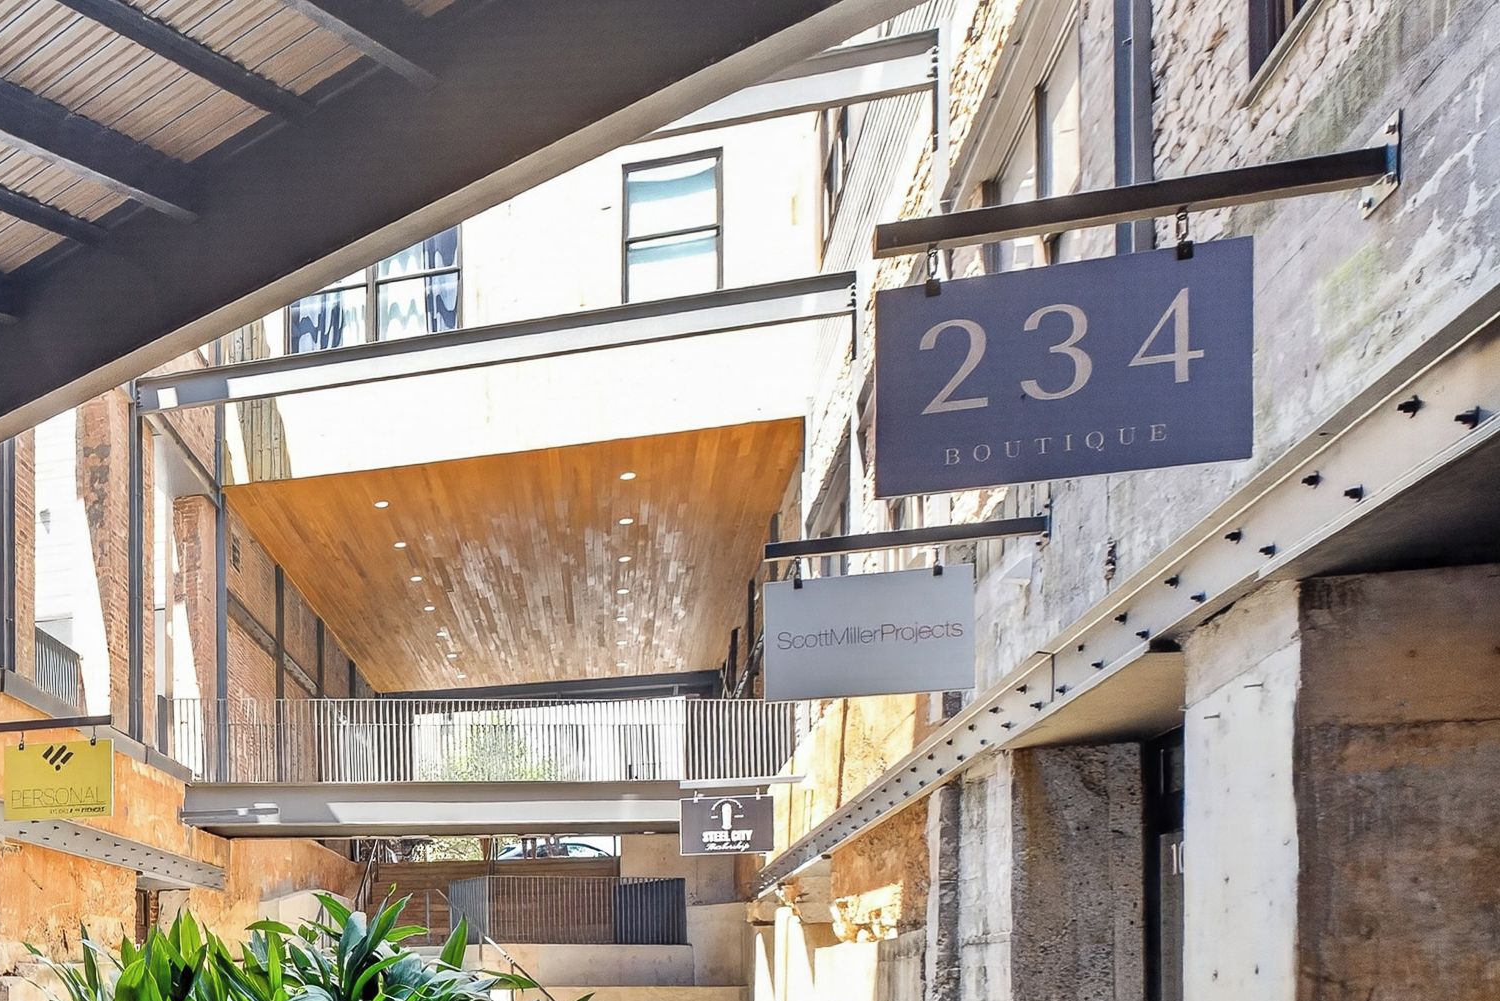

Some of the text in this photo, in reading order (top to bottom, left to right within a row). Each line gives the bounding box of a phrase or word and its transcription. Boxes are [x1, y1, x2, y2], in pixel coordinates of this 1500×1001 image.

[919, 287, 1205, 416] 234
[945, 423, 1168, 466] BOUTIQUE
[776, 621, 964, 651] ScottMillerProjects
[11, 787, 106, 808] PERSONAL
[702, 829, 754, 843] STEEL CITY
